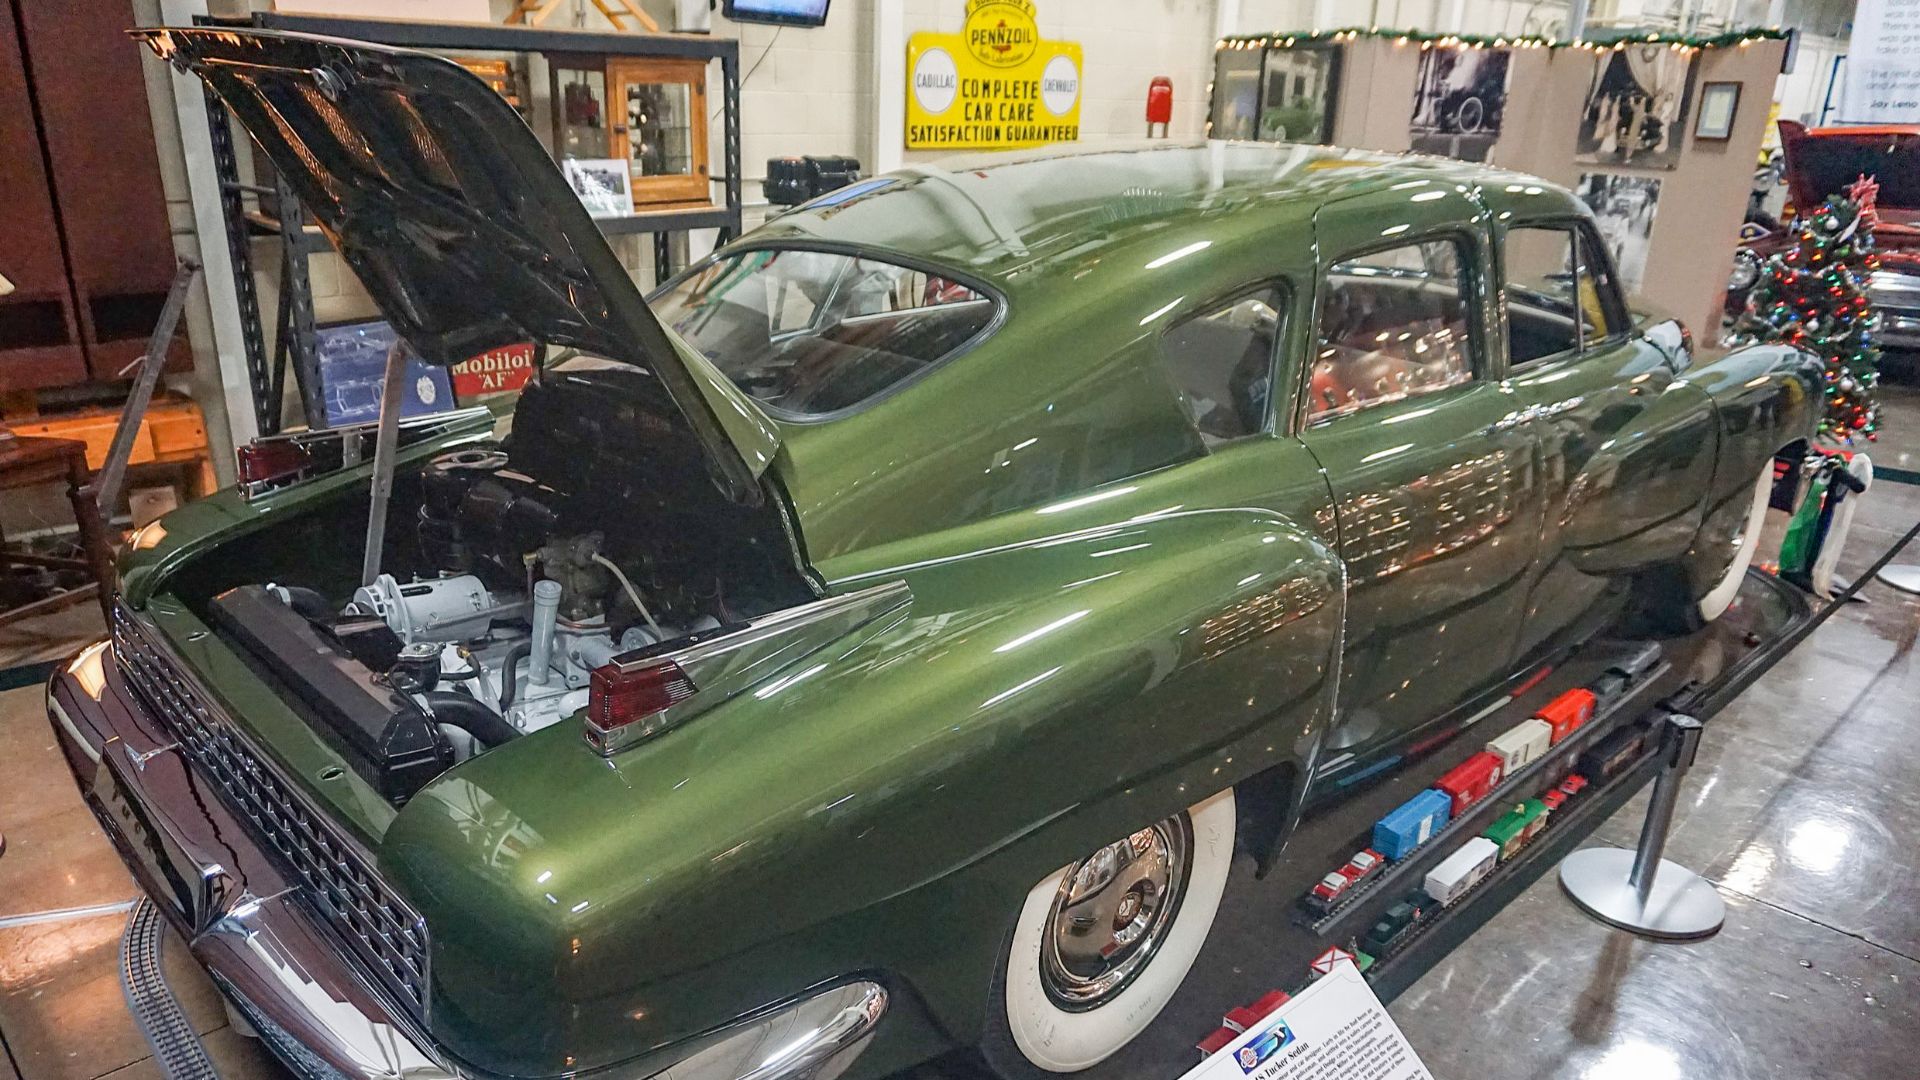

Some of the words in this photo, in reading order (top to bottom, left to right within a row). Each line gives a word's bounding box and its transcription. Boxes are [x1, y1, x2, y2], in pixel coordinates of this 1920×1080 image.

[971, 28, 1033, 46] PENNZOIL
[916, 73, 955, 89] CADILLAC
[962, 78, 1038, 99] COMPLETE
[1044, 79, 1076, 93] CHEVROLET
[964, 102, 993, 121] CAR
[999, 103, 1034, 121] CARE
[911, 125, 1000, 142] SATISFACTION
[1006, 125, 1079, 142] GUARANTEED
[1264, 1057, 1288, 1078] Tucker
[1288, 1043, 1309, 1059] Sedan
